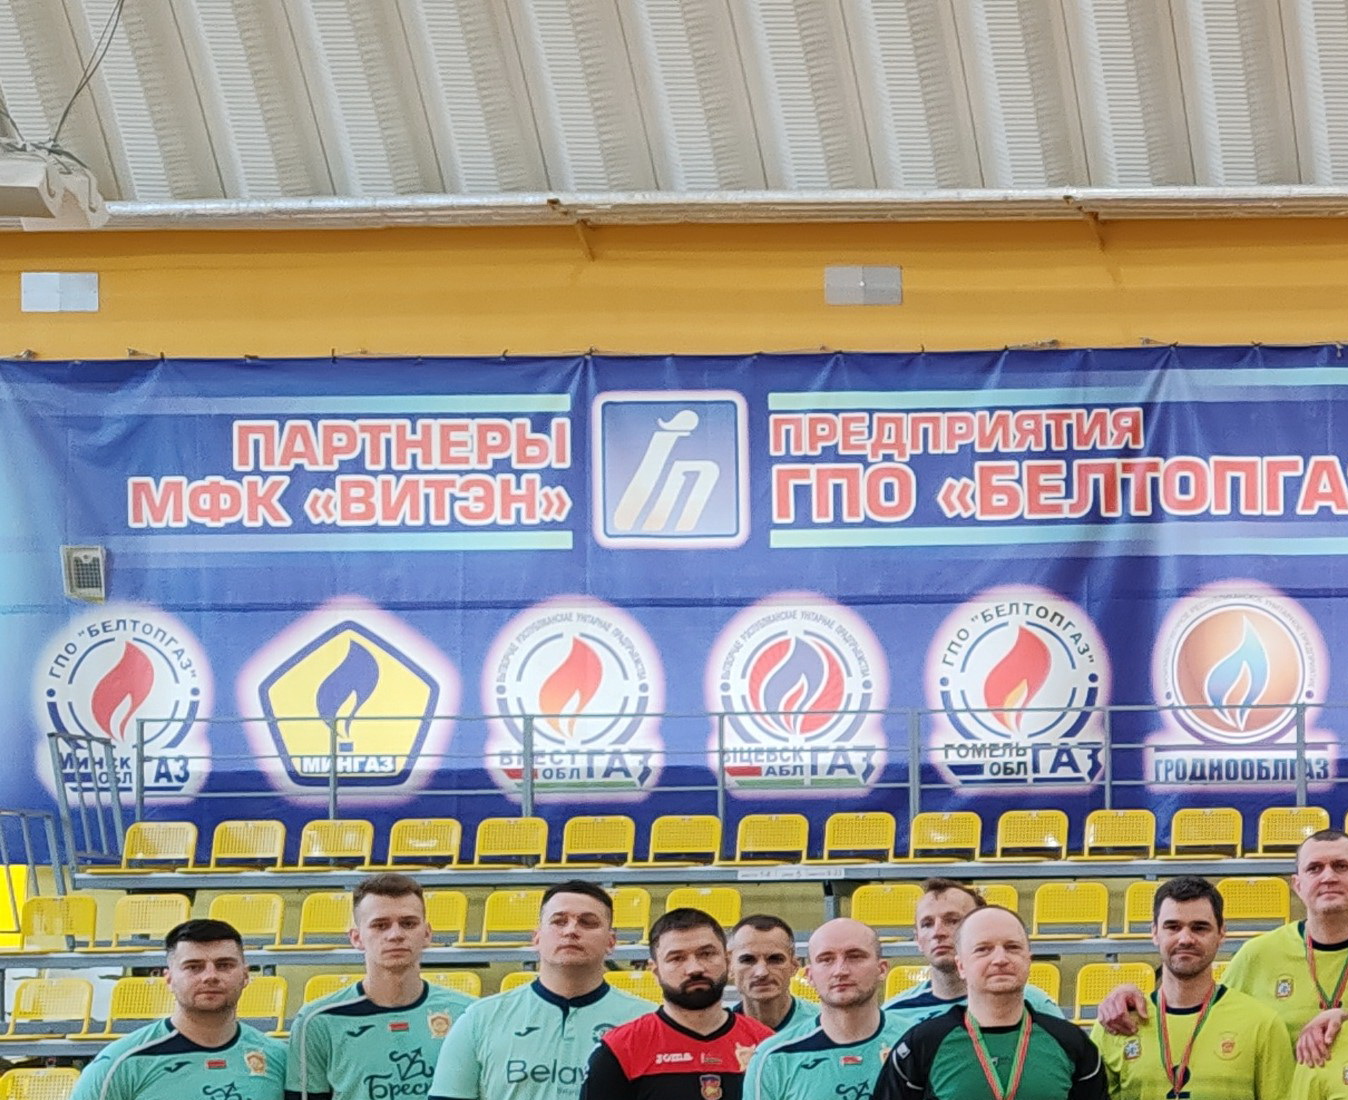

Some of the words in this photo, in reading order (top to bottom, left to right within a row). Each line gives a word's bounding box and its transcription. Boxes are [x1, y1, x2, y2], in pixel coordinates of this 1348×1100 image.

[233, 418, 571, 472] ПАРТНЕРЫ
[768, 408, 1145, 462] ПРЕДПРИЯТИЯ
[127, 478, 286, 525] МФК
[305, 475, 571, 528] «ВИТЭН»
[772, 463, 915, 522] ГПО
[942, 627, 971, 667] ГПО
[971, 602, 1095, 663] "БЕЛТОПГАЗ"
[49, 642, 78, 678] ГПО
[302, 756, 395, 773] МИНГАЗ
[585, 750, 652, 786] ГАЗ
[810, 746, 876, 783] ГАЗ
[944, 743, 1027, 758] ГОМЕЛЬ
[989, 762, 1027, 775] ОБЛ
[1032, 742, 1102, 781] ГАЗ
[542, 767, 580, 779] ОБЛ
[764, 765, 803, 776] АБЛ
